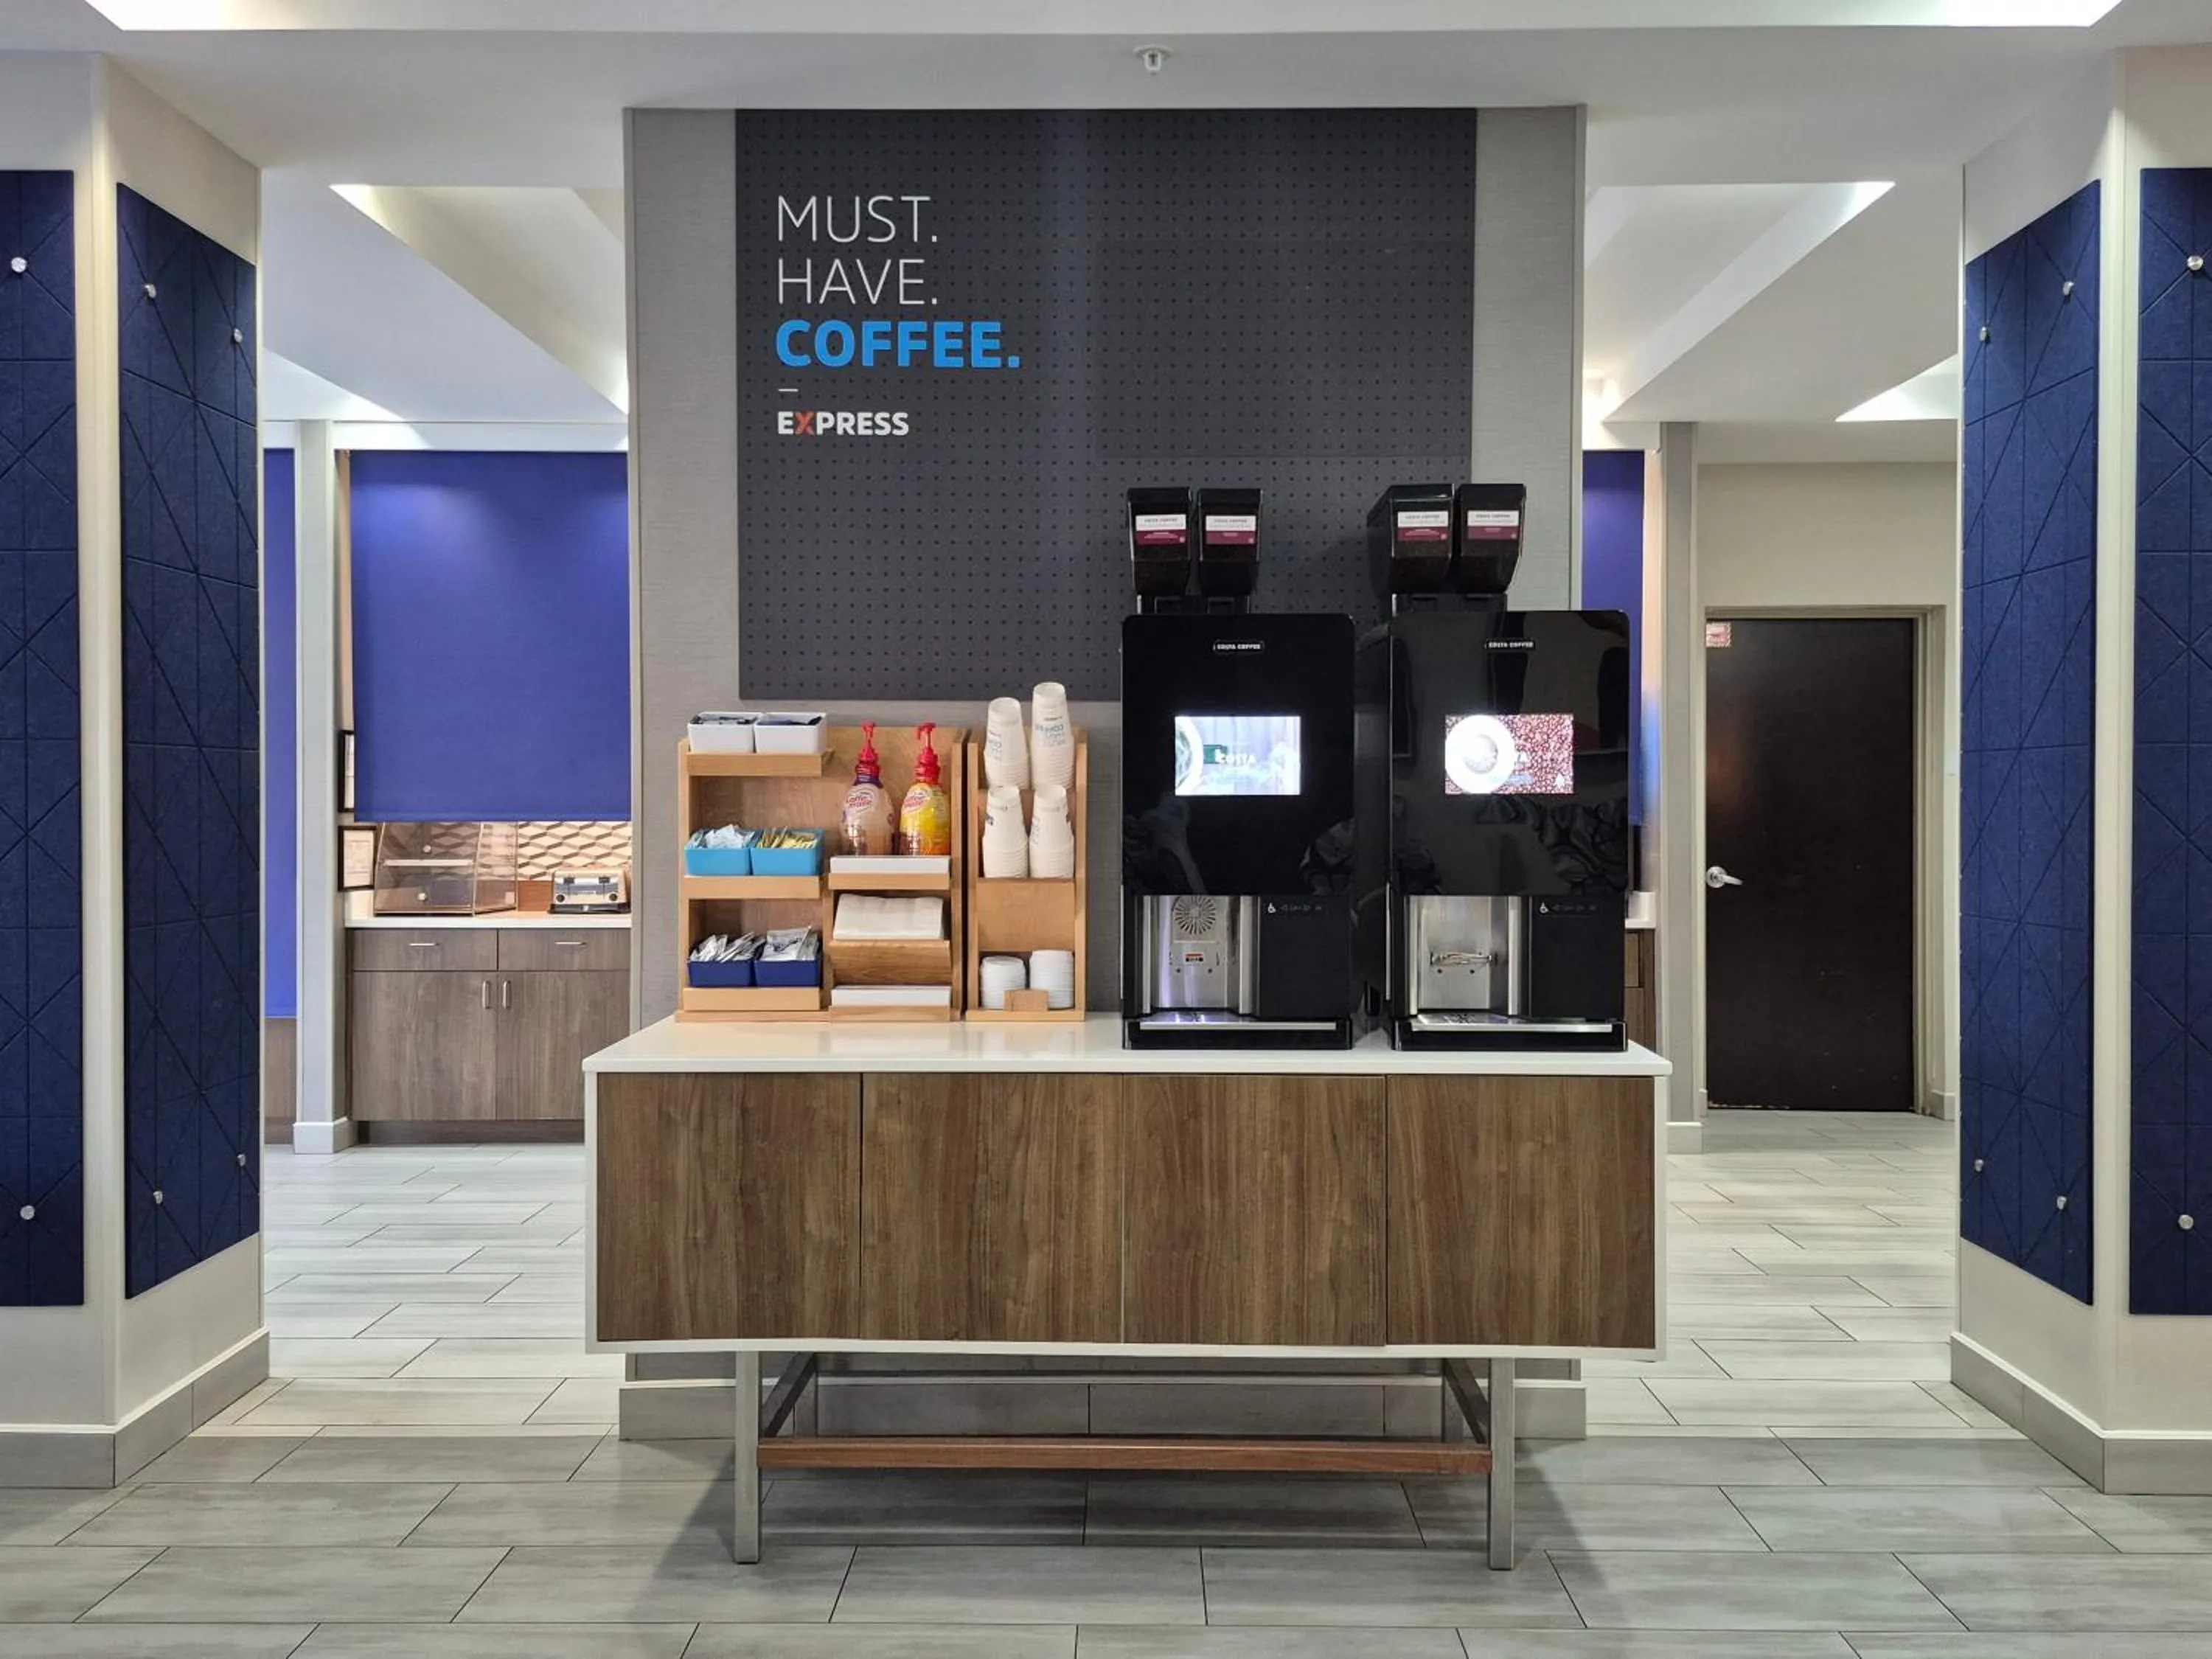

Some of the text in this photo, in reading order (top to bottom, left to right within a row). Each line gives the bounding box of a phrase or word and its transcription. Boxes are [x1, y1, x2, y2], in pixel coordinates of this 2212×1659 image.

[779, 195, 937, 242] MUST.
[779, 258, 937, 305] HAVE.
[776, 319, 1020, 367] COFFEE.
[778, 411, 908, 435] EXPRESS
